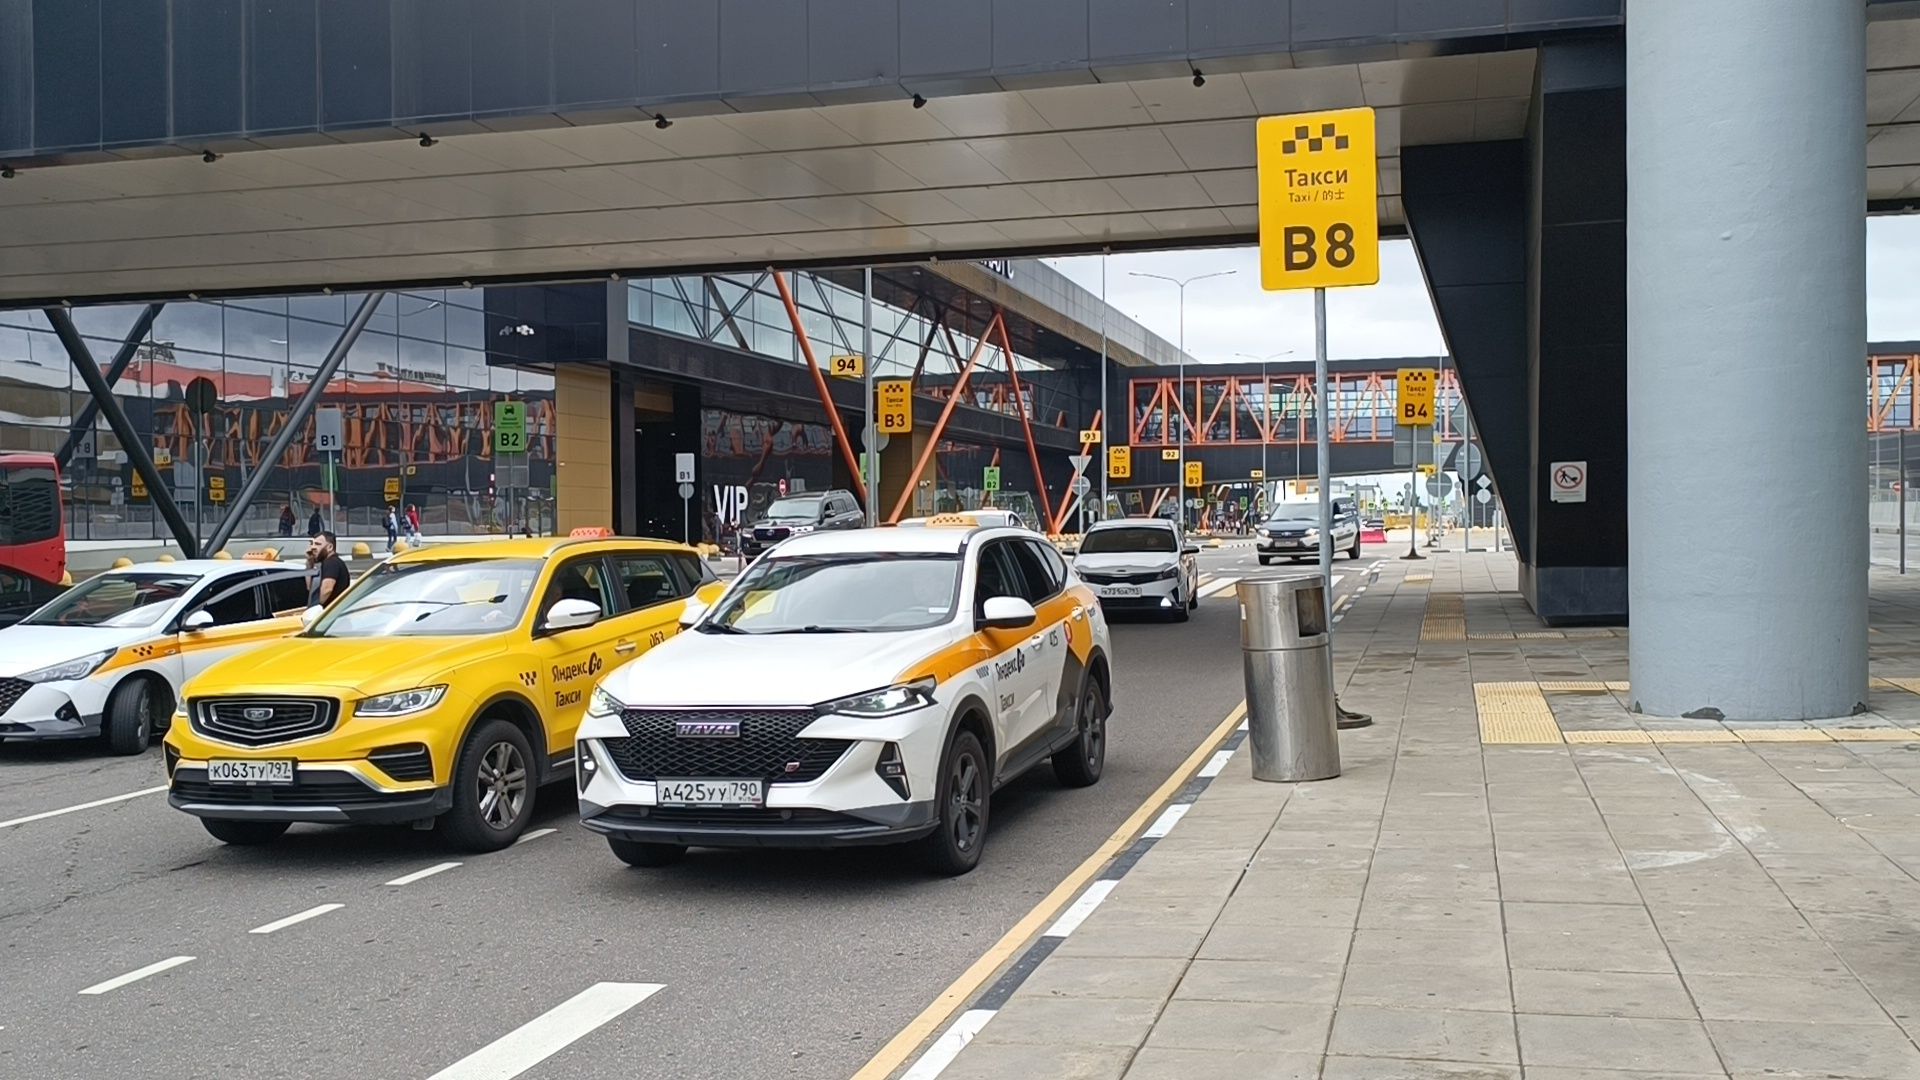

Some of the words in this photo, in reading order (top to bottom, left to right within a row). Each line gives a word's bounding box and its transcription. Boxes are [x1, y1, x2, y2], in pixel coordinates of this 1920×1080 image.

[1284, 169, 1348, 187] Такси
[1289, 191, 1311, 203] Taxi
[1314, 191, 1319, 203] /
[1322, 189, 1345, 201] 的士
[1284, 223, 1355, 271] B8
[837, 359, 856, 371] 94
[1405, 403, 1427, 418] B4
[884, 414, 905, 428] B3
[321, 435, 336, 446] B1
[501, 433, 519, 446] B2
[1084, 433, 1096, 441] 93
[680, 471, 691, 480] B1
[1113, 466, 1127, 475] B3
[713, 484, 748, 526] VIP
[551, 661, 588, 682] Яндекс
[588, 652, 602, 676] Go
[554, 690, 582, 708] Такси
[679, 725, 736, 735] HAVAL
[268, 762, 288, 774] 797
[731, 783, 757, 796] 790
